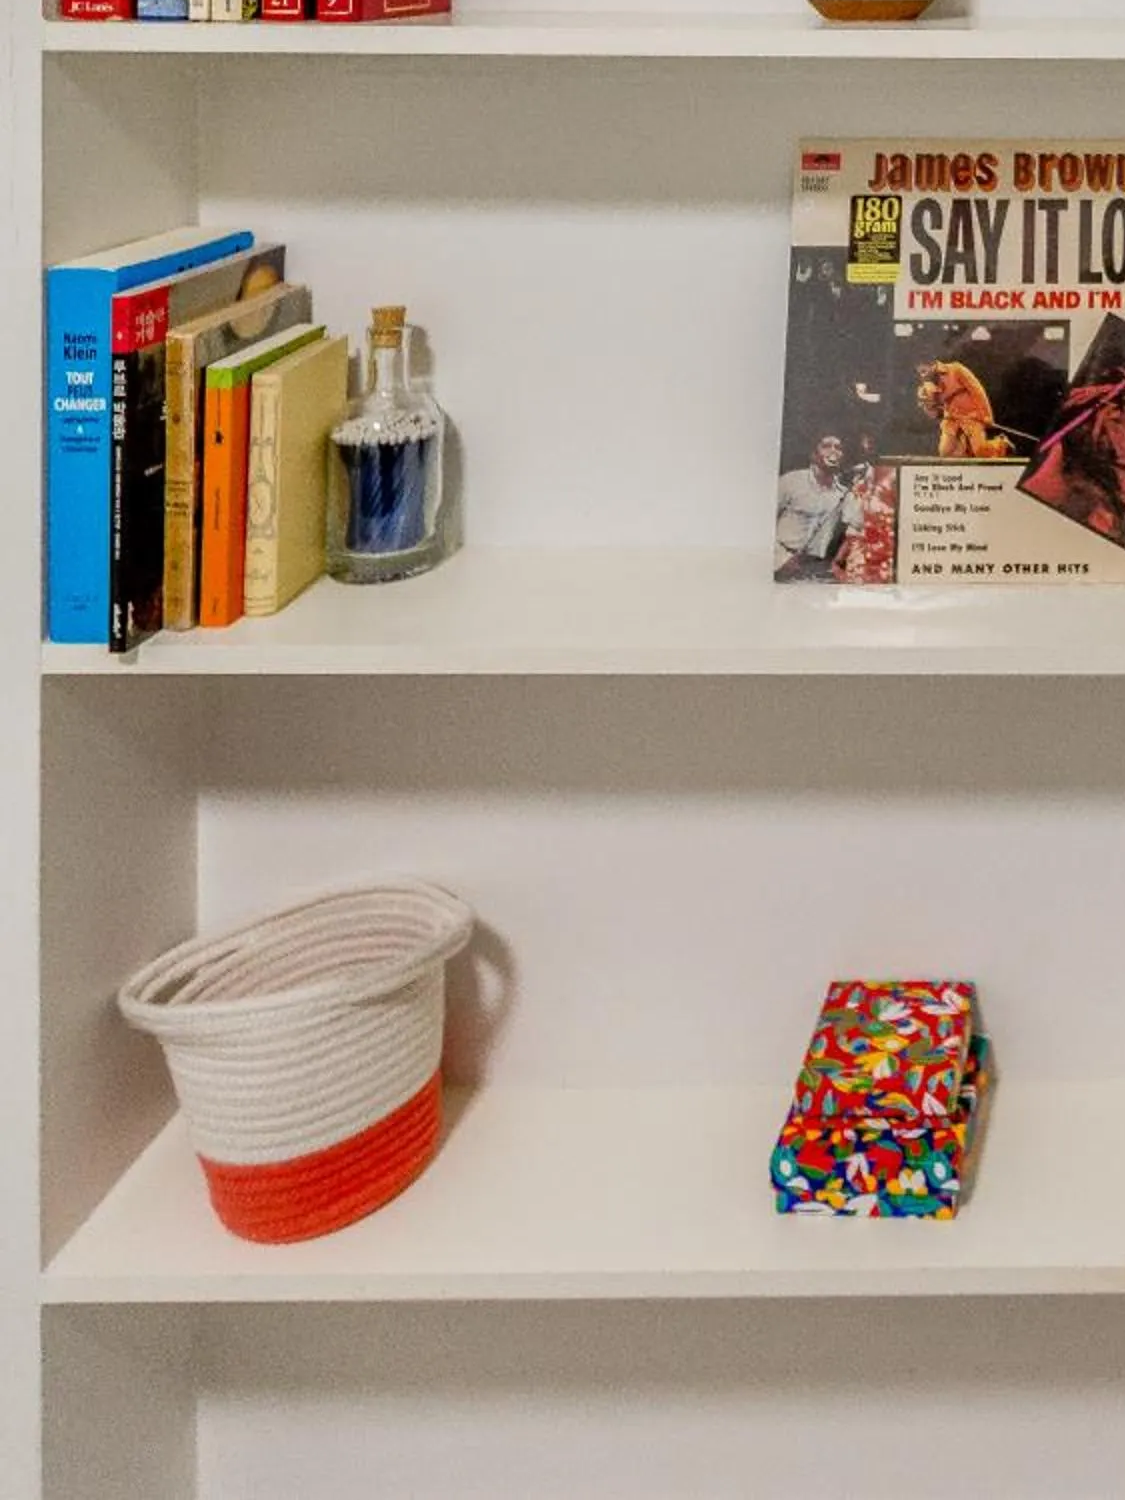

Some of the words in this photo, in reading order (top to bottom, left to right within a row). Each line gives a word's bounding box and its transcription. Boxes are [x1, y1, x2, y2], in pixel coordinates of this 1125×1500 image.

[868, 152, 999, 193] James
[855, 197, 899, 221] 180
[853, 220, 897, 238] gram
[910, 198, 1010, 285] SAY
[1022, 198, 1068, 284] IT
[907, 290, 943, 309] I'M
[950, 290, 1025, 309] BLACK
[1031, 290, 1080, 309] AND
[1088, 290, 1121, 309] I'M
[64, 346, 97, 360] Klein
[65, 371, 94, 385] TOUT
[54, 397, 106, 411] CHANGER
[911, 563, 943, 575] AND
[951, 563, 996, 575] MANY
[1002, 563, 1049, 575] OTHER
[1057, 563, 1090, 575] HITS
